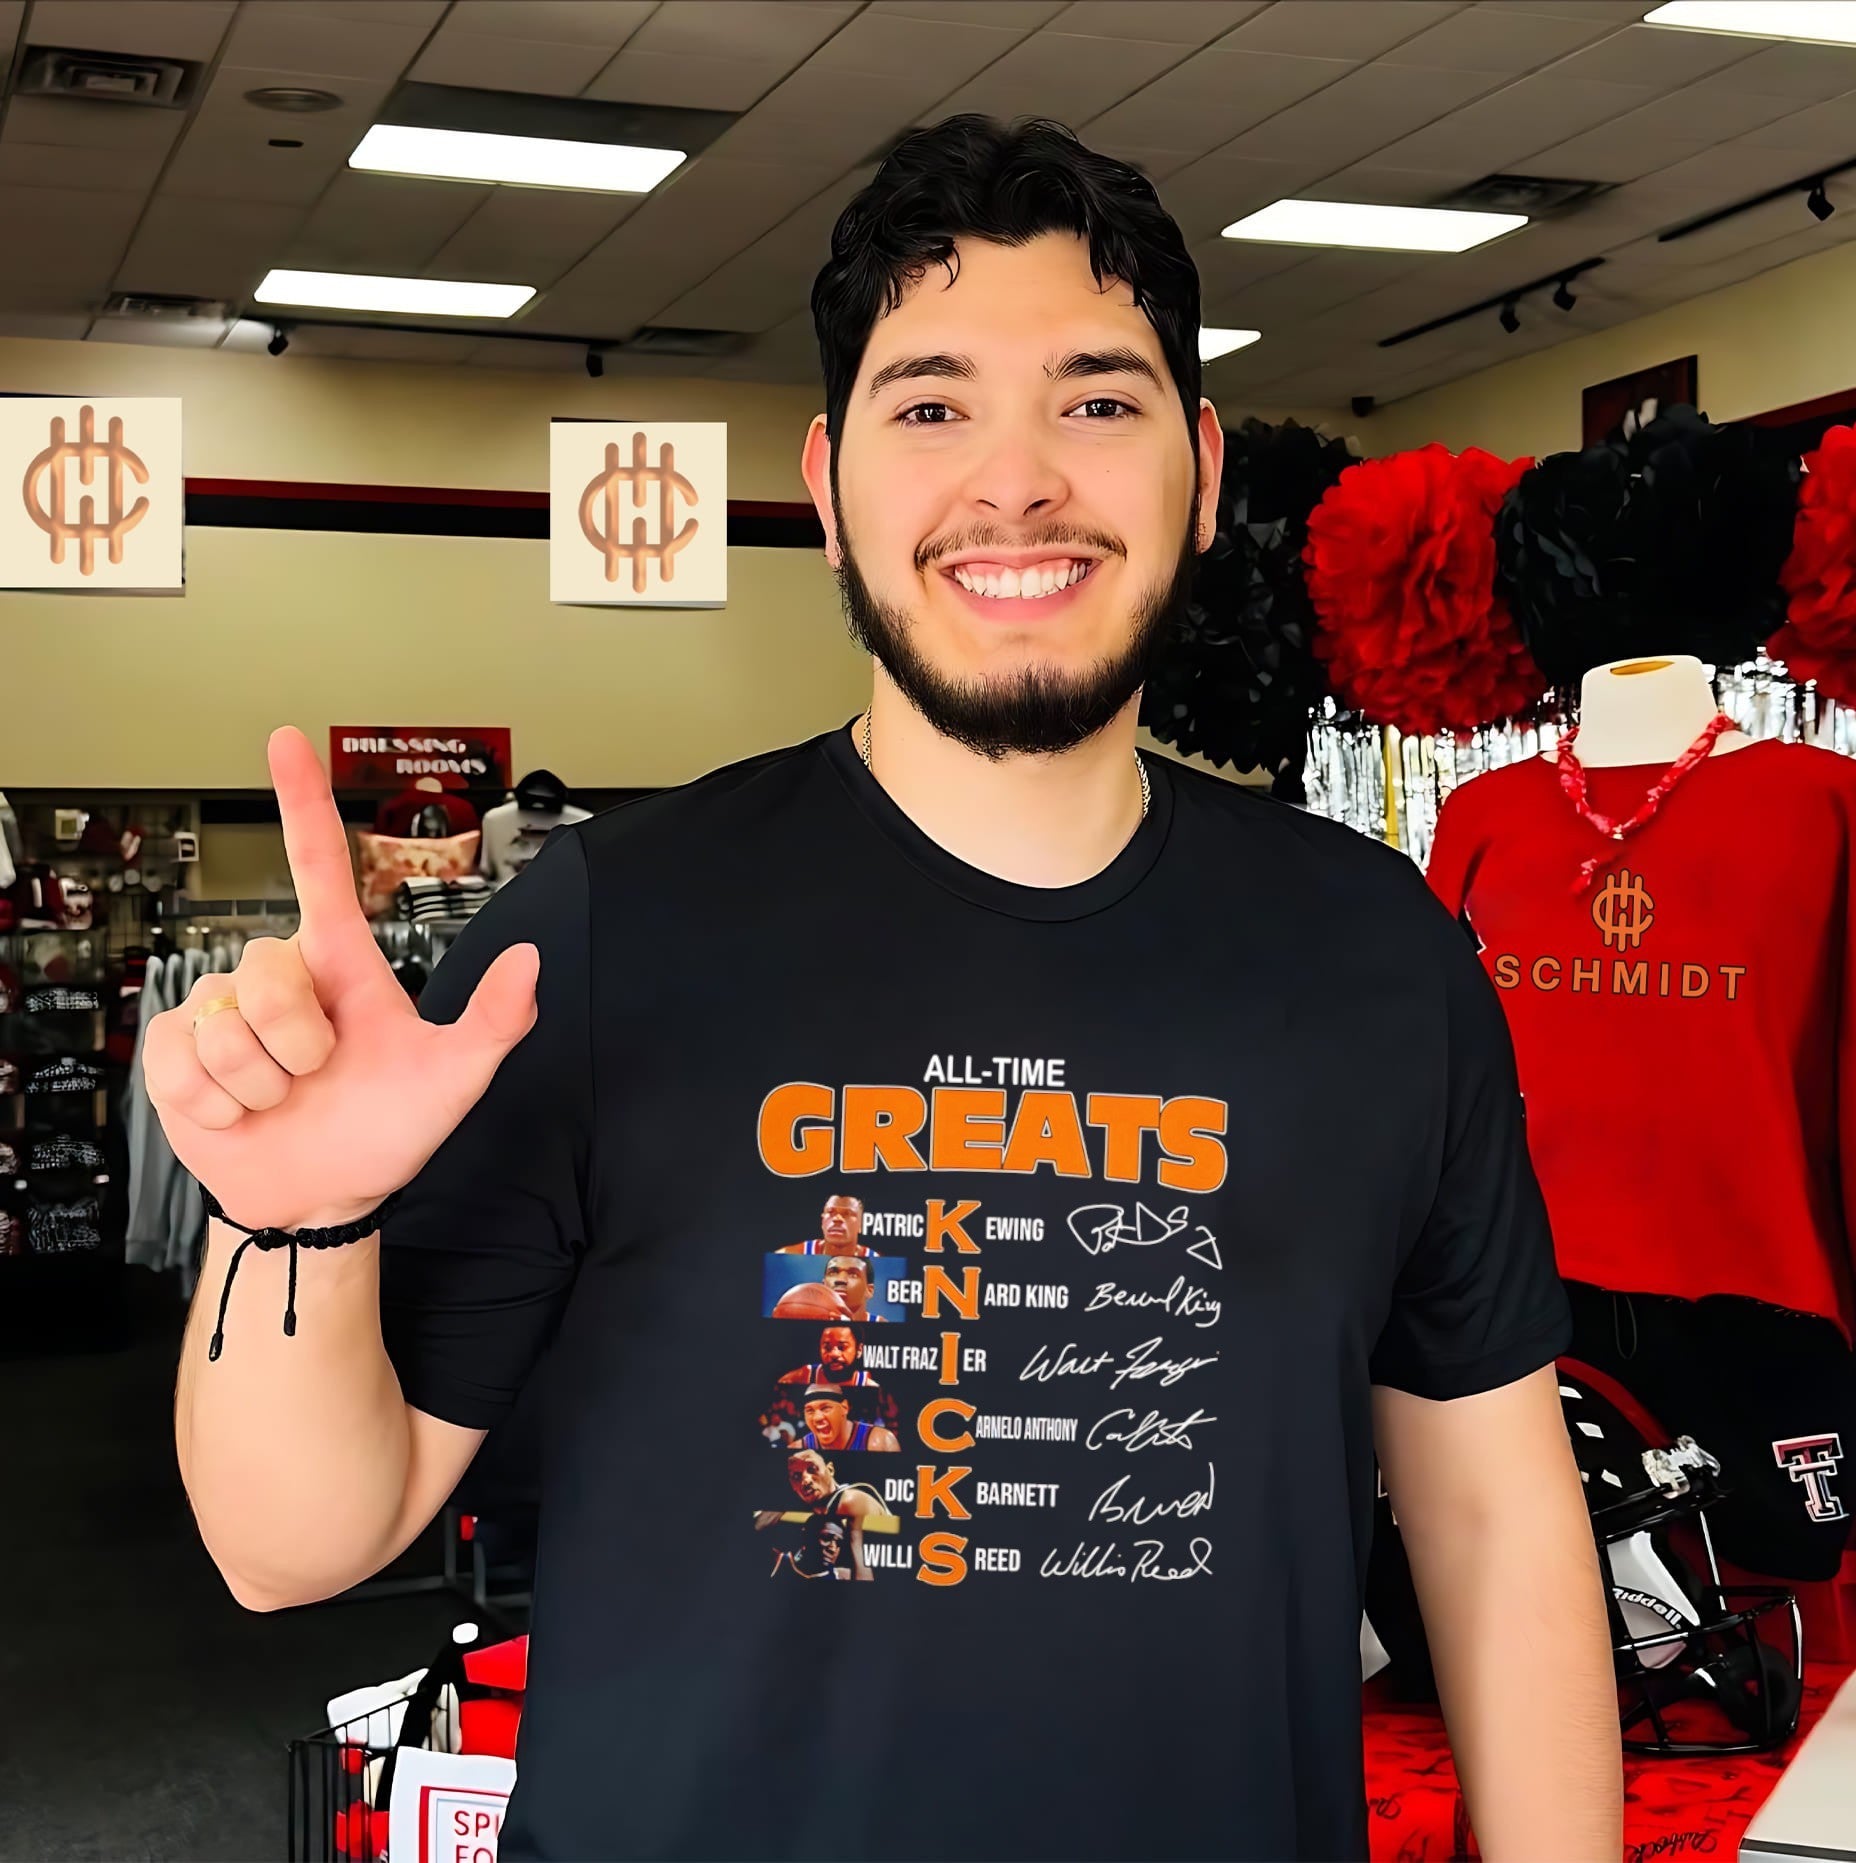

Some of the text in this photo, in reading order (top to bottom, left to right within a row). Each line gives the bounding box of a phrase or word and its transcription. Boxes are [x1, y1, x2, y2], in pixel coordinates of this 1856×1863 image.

[396, 758, 487, 775] ROOMS
[1493, 953, 1747, 1000] SCHMIDT
[923, 1054, 1066, 1088] ALL-TIME
[757, 1081, 1229, 1194] GREATS
[985, 1216, 1045, 1242] EWING
[1025, 1284, 1069, 1309] KING
[863, 1344, 900, 1369] WALT
[1023, 1417, 1079, 1443] ANTHONY
[976, 1481, 1060, 1508] BARNETT
[974, 1547, 1022, 1573] REED
